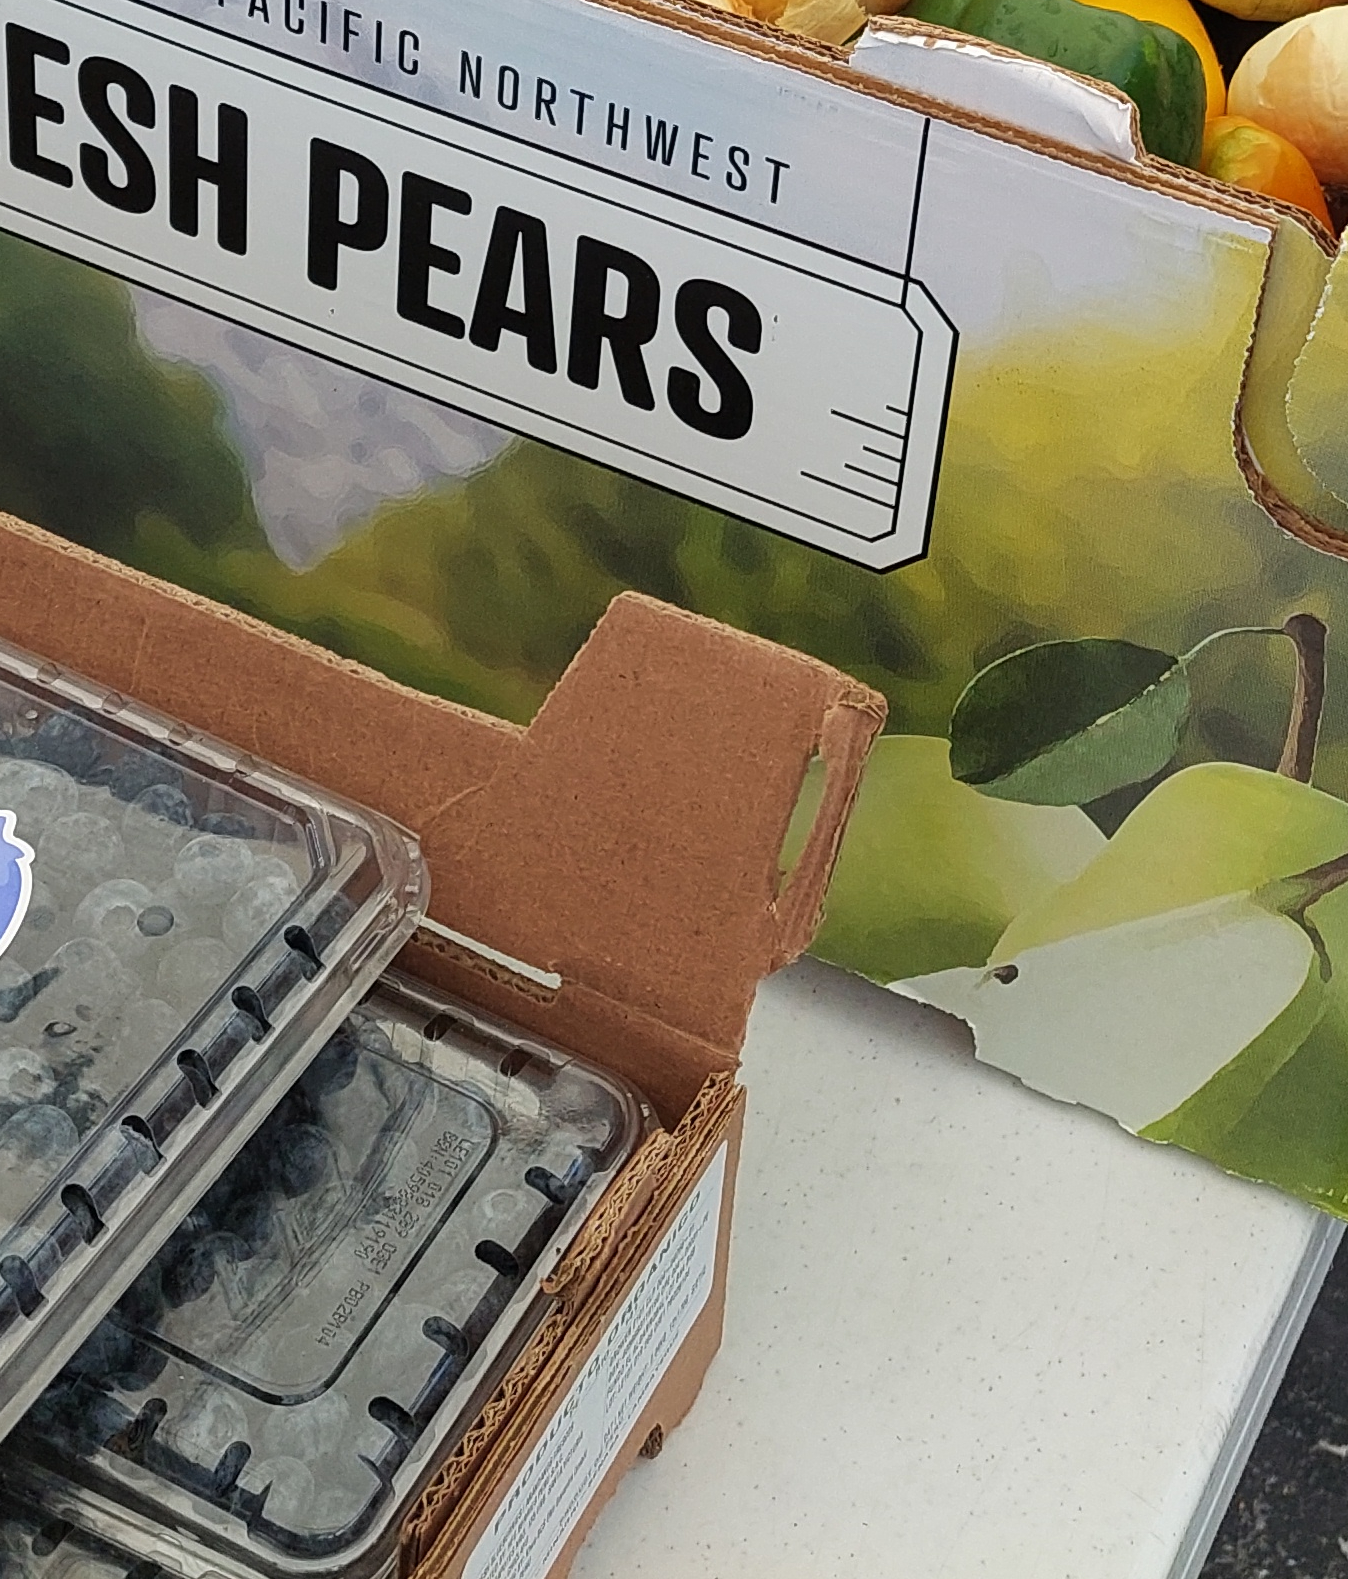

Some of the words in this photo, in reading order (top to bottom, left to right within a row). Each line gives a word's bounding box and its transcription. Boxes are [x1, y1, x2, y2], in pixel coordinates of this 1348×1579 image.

[458, 49, 792, 206] NORTHWEST
[306, 137, 764, 442] PEARS
[492, 1352, 601, 1536] PRODUCTO
[606, 1189, 703, 1347] ORGANICO
